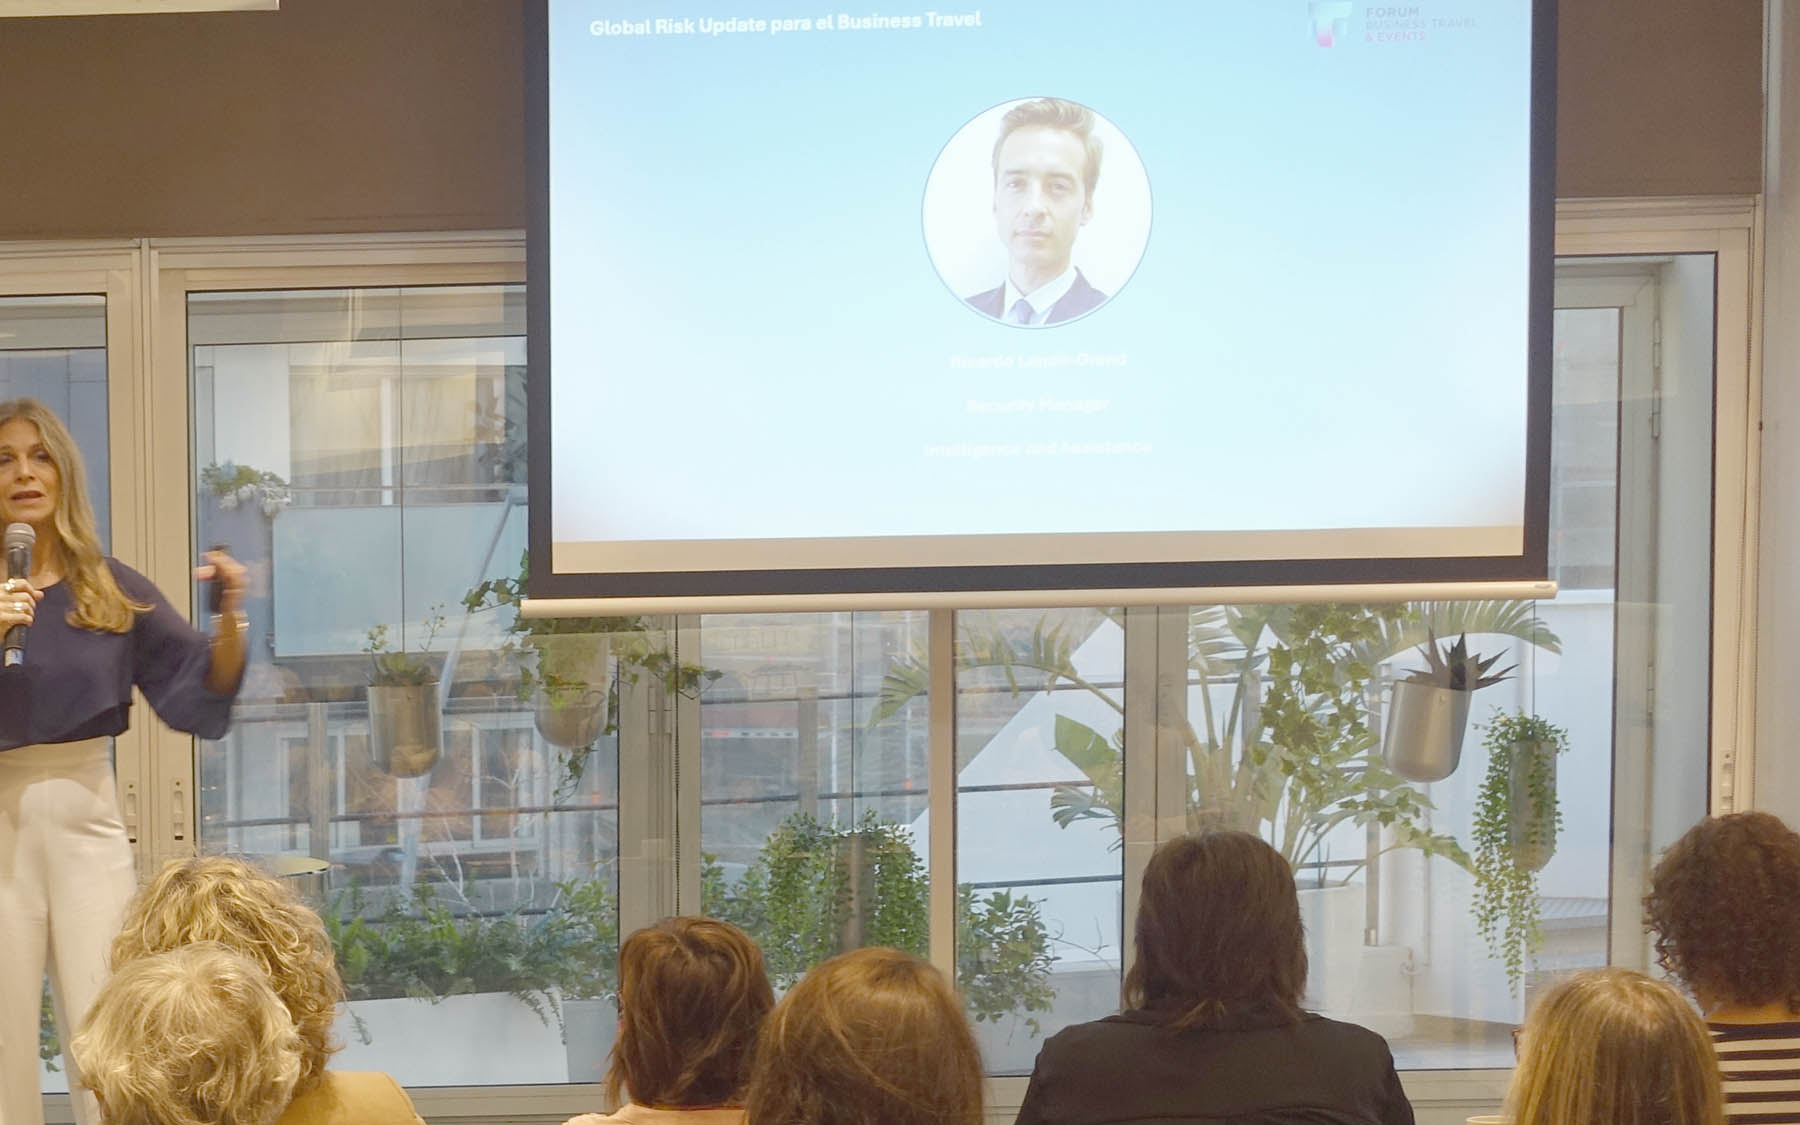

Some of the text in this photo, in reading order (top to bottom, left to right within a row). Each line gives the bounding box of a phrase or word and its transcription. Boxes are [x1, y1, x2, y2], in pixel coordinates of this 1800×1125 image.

[1365, 7, 1420, 18] FORUM
[589, 10, 982, 37] Global Risk Update para el Business Travel
